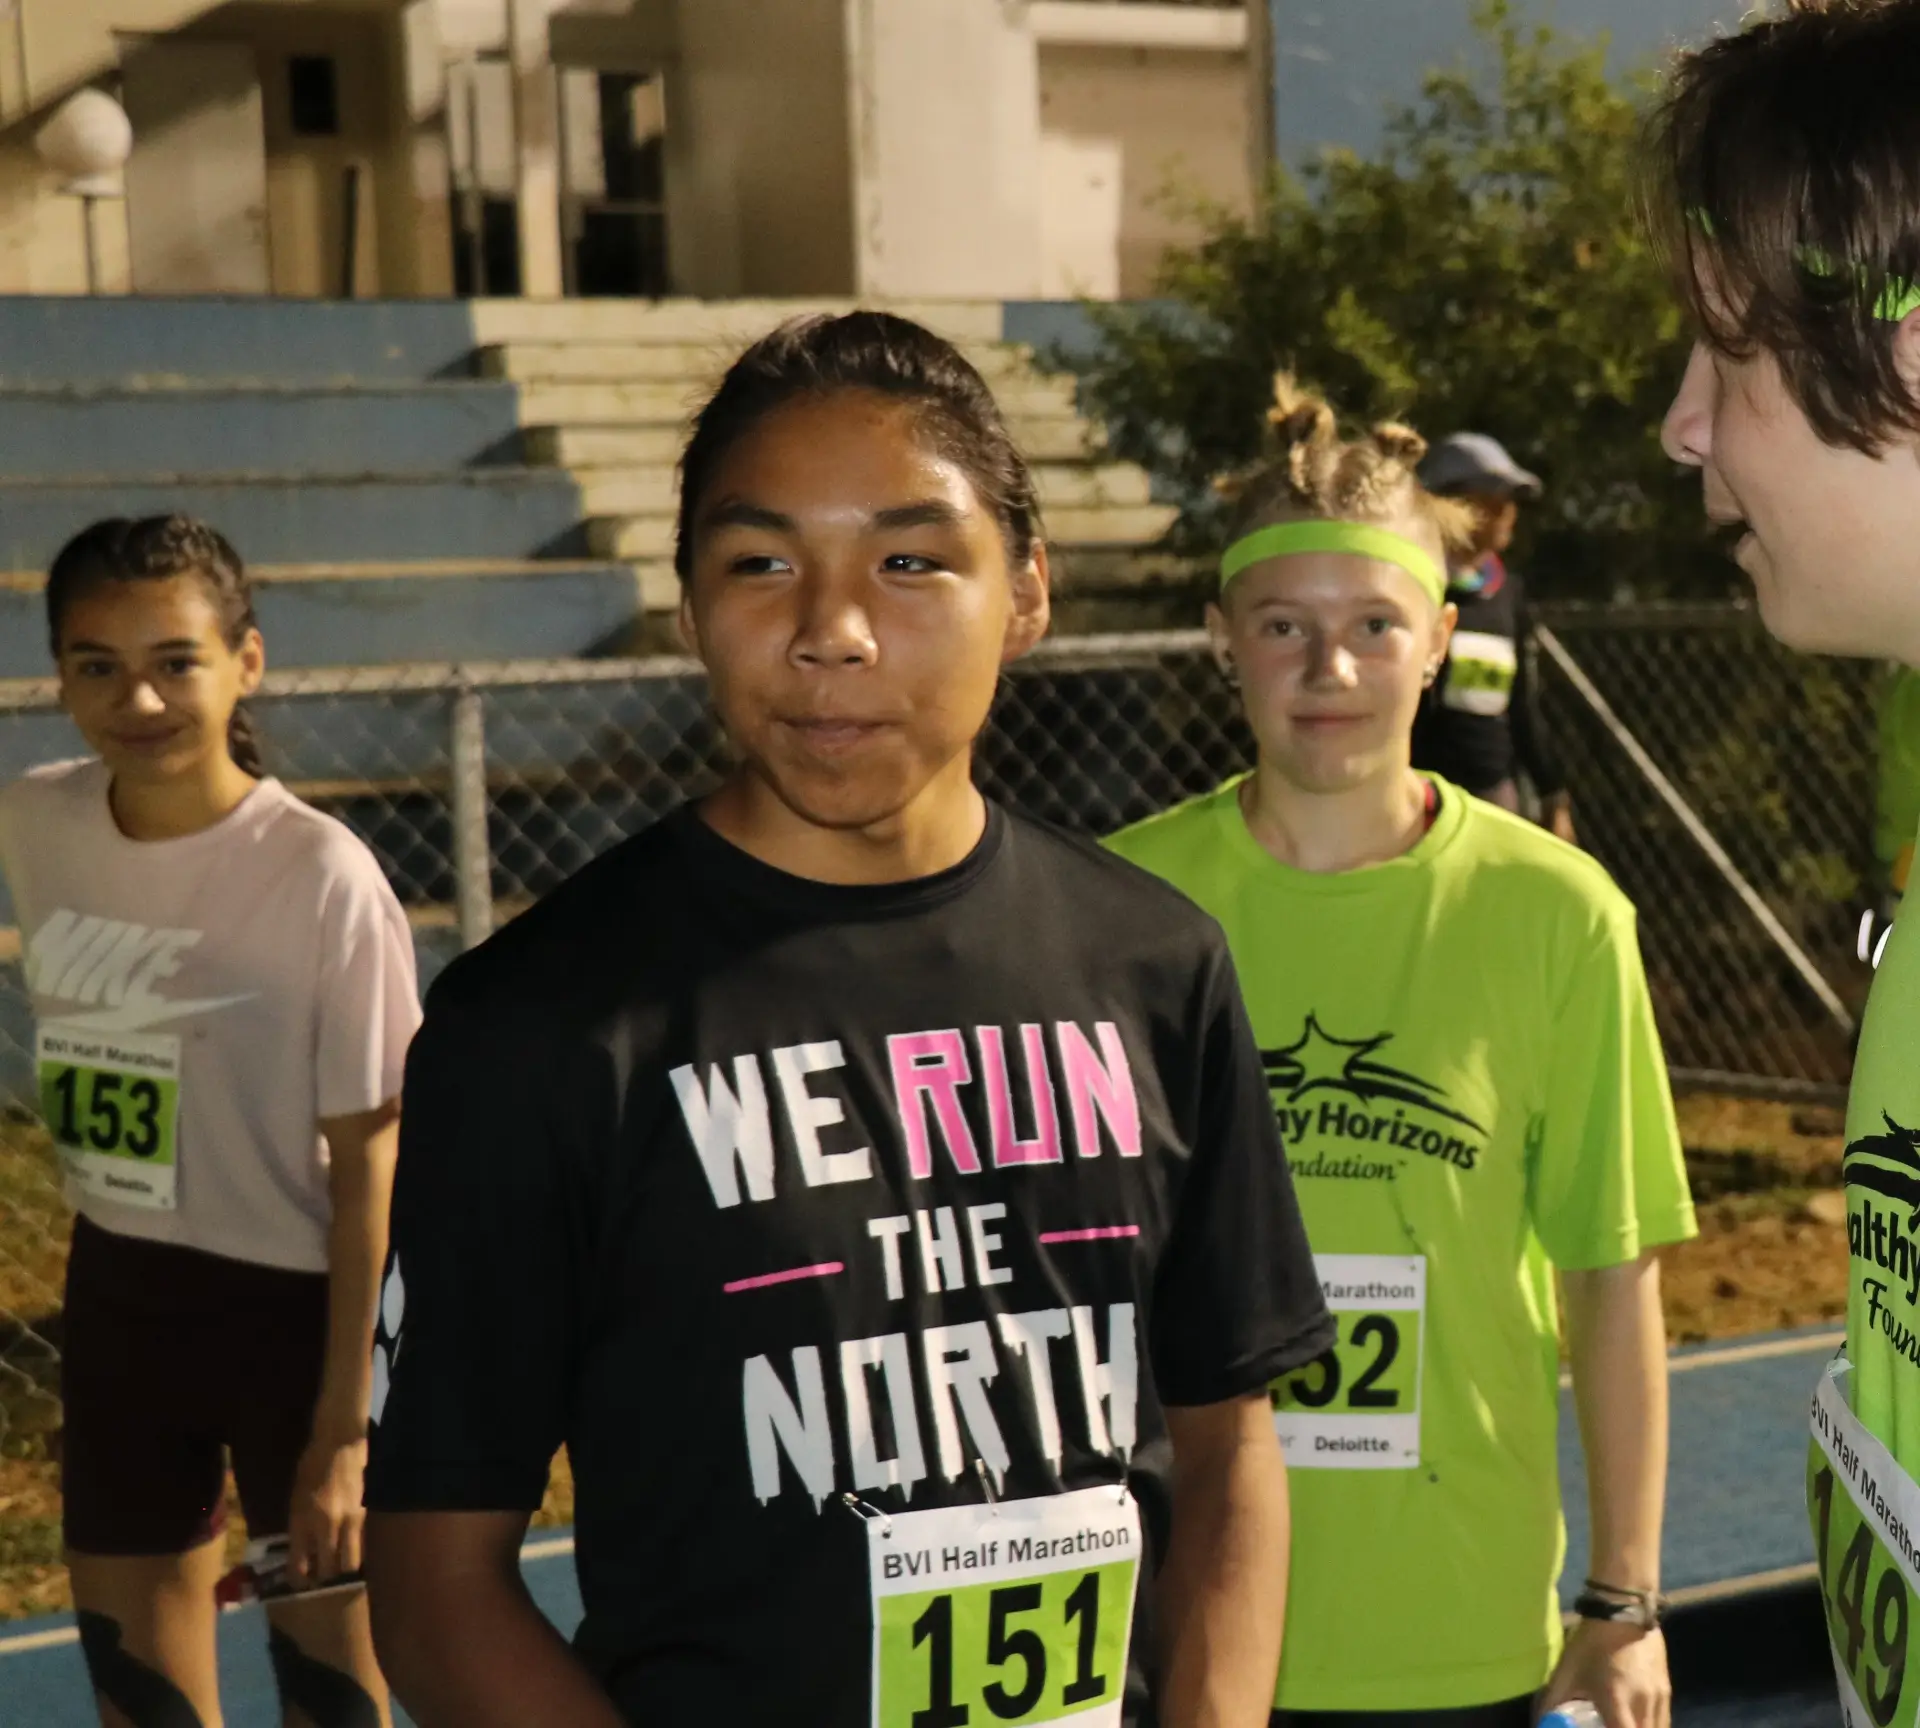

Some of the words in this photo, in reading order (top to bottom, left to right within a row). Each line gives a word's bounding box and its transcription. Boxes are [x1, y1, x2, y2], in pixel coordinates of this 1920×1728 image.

[29, 908, 203, 1006] NIKE
[43, 1037, 68, 1054] BVI
[72, 1041, 102, 1059] Half
[105, 1045, 175, 1071] Marathon
[53, 1066, 162, 1158] 153
[668, 1040, 874, 1209] WE
[886, 1020, 1142, 1180] RUN
[1318, 1100, 1480, 1170] Horizons
[868, 1203, 1013, 1300] THE
[1320, 1281, 1416, 1299] Marathon
[1270, 1313, 1400, 1408] 52
[742, 1302, 1140, 1516] NORTH
[1314, 1436, 1391, 1452] Deloitte
[1811, 1394, 1829, 1438] BVI
[1832, 1424, 1860, 1482] Half
[883, 1550, 931, 1579] BVI
[942, 1540, 999, 1572] Half
[1008, 1526, 1130, 1564] Marathon
[1814, 1464, 1908, 1728] 149
[912, 1571, 1106, 1728] 151
